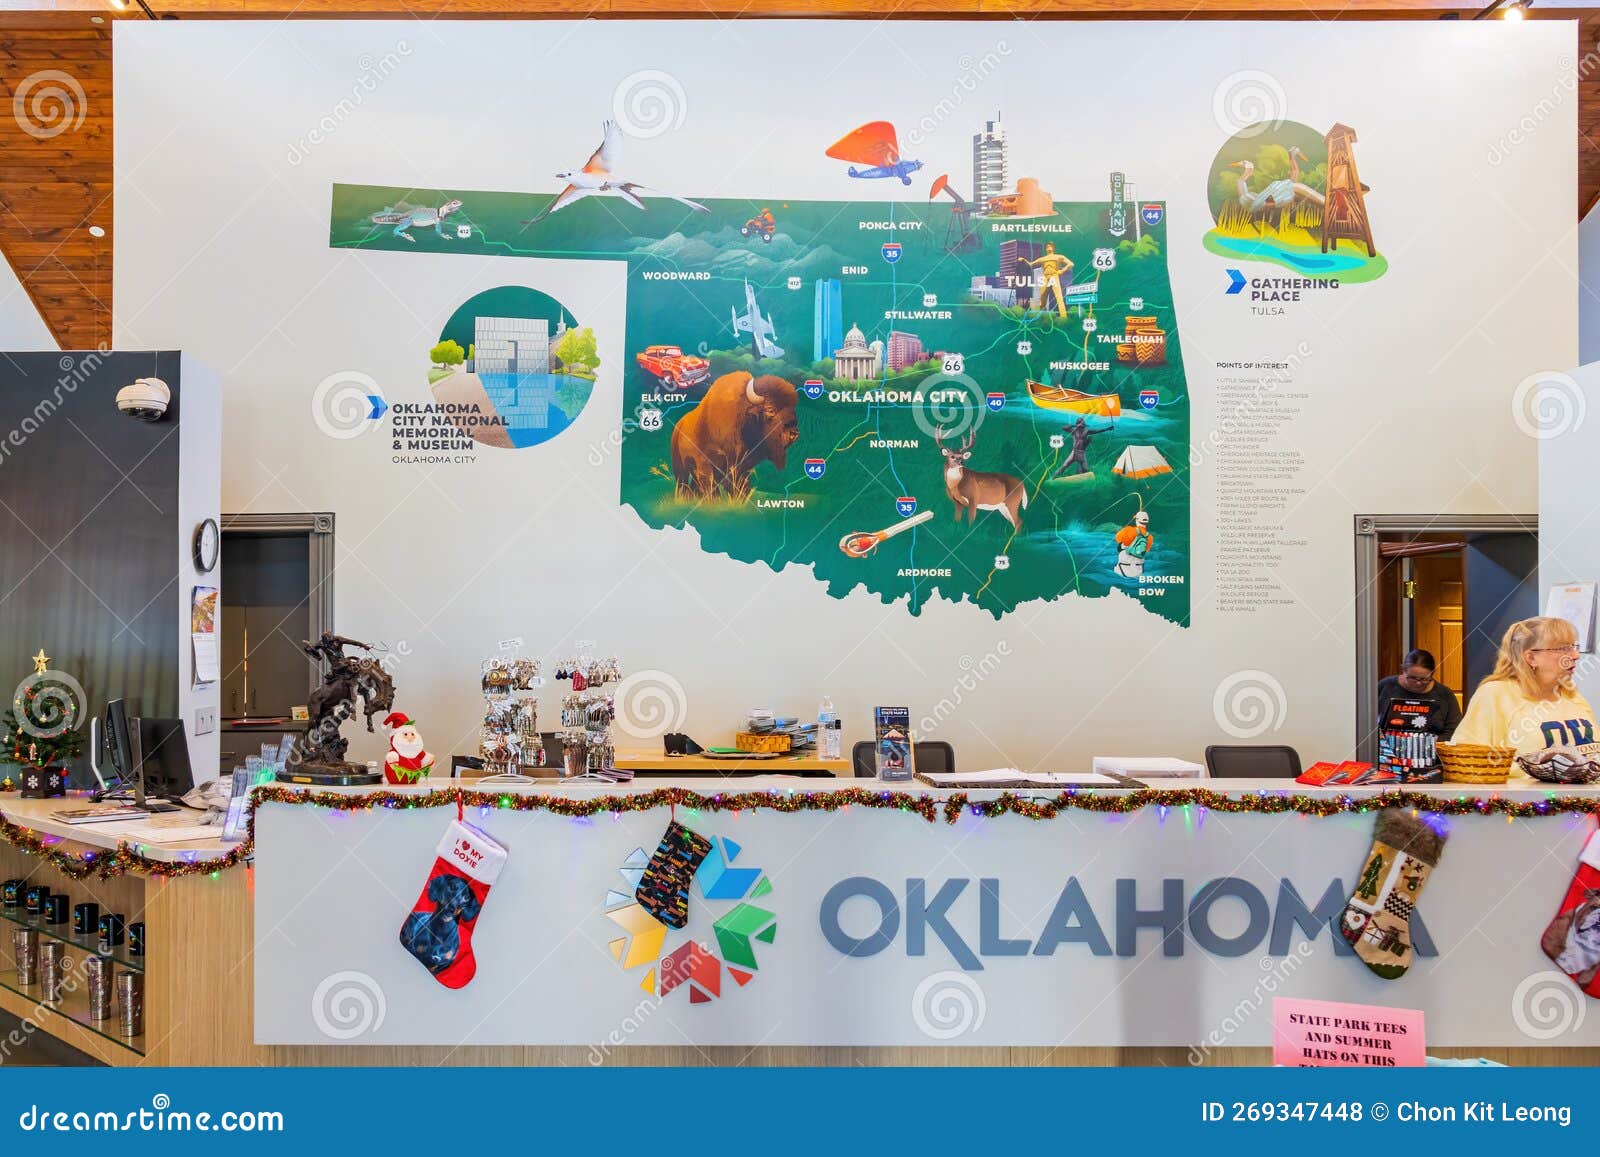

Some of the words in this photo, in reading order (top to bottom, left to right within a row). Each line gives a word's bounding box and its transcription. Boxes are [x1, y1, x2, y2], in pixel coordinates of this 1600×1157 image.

[1146, 212, 1159, 220] 44
[859, 222, 896, 230] PONCA
[898, 222, 922, 230] CITY
[992, 224, 1072, 233] BARTLESVILLE
[886, 250, 898, 258] 35
[1096, 255, 1112, 266] 66
[842, 266, 868, 275] ENID
[643, 271, 711, 281] WOODWARD
[1005, 275, 1058, 287] TULSA
[1251, 278, 1340, 289] GATHERING
[1251, 291, 1301, 302] PLACE
[885, 311, 952, 320] STILLWATER
[1251, 307, 1285, 316] TULSA
[1097, 335, 1163, 344] TAHLEQUAH
[944, 360, 961, 372] 66
[1050, 362, 1110, 371] MUSKOGEE
[1255, 362, 1288, 370] INTEREST
[641, 394, 660, 402] ELK
[663, 394, 687, 402] CITY
[828, 391, 924, 403] OKLAHOMA
[929, 391, 968, 403] CITY
[392, 403, 481, 414] OKLAHOMA
[392, 415, 428, 426] CITY
[431, 415, 509, 426] NATIONAL
[643, 417, 659, 427] 66
[392, 427, 474, 438] MEMORIAL
[392, 439, 403, 450] &
[407, 439, 474, 450] MUSEUM
[870, 440, 918, 448] NORMAN
[392, 455, 451, 463] OKLAHOMA
[453, 455, 476, 463] CITY
[808, 466, 821, 474] 44
[757, 499, 804, 509] LAWTON
[901, 504, 913, 512] 35
[897, 568, 952, 577] ARDMORE
[1139, 575, 1184, 584] BROKEN
[1139, 587, 1165, 596] BOW
[1392, 704, 1429, 713] FLOATING
[453, 848, 478, 869] DOXIE
[470, 848, 484, 862] MY
[1290, 1013, 1331, 1027] STATE
[1334, 1018, 1371, 1031] PARK
[1373, 1022, 1408, 1035] TEES
[1305, 1031, 1332, 1043] AND
[1335, 1034, 1393, 1050] SUMMER
[1303, 1047, 1338, 1061] HATS
[1341, 1052, 1359, 1063] ON
[1362, 1054, 1396, 1067] THIS
